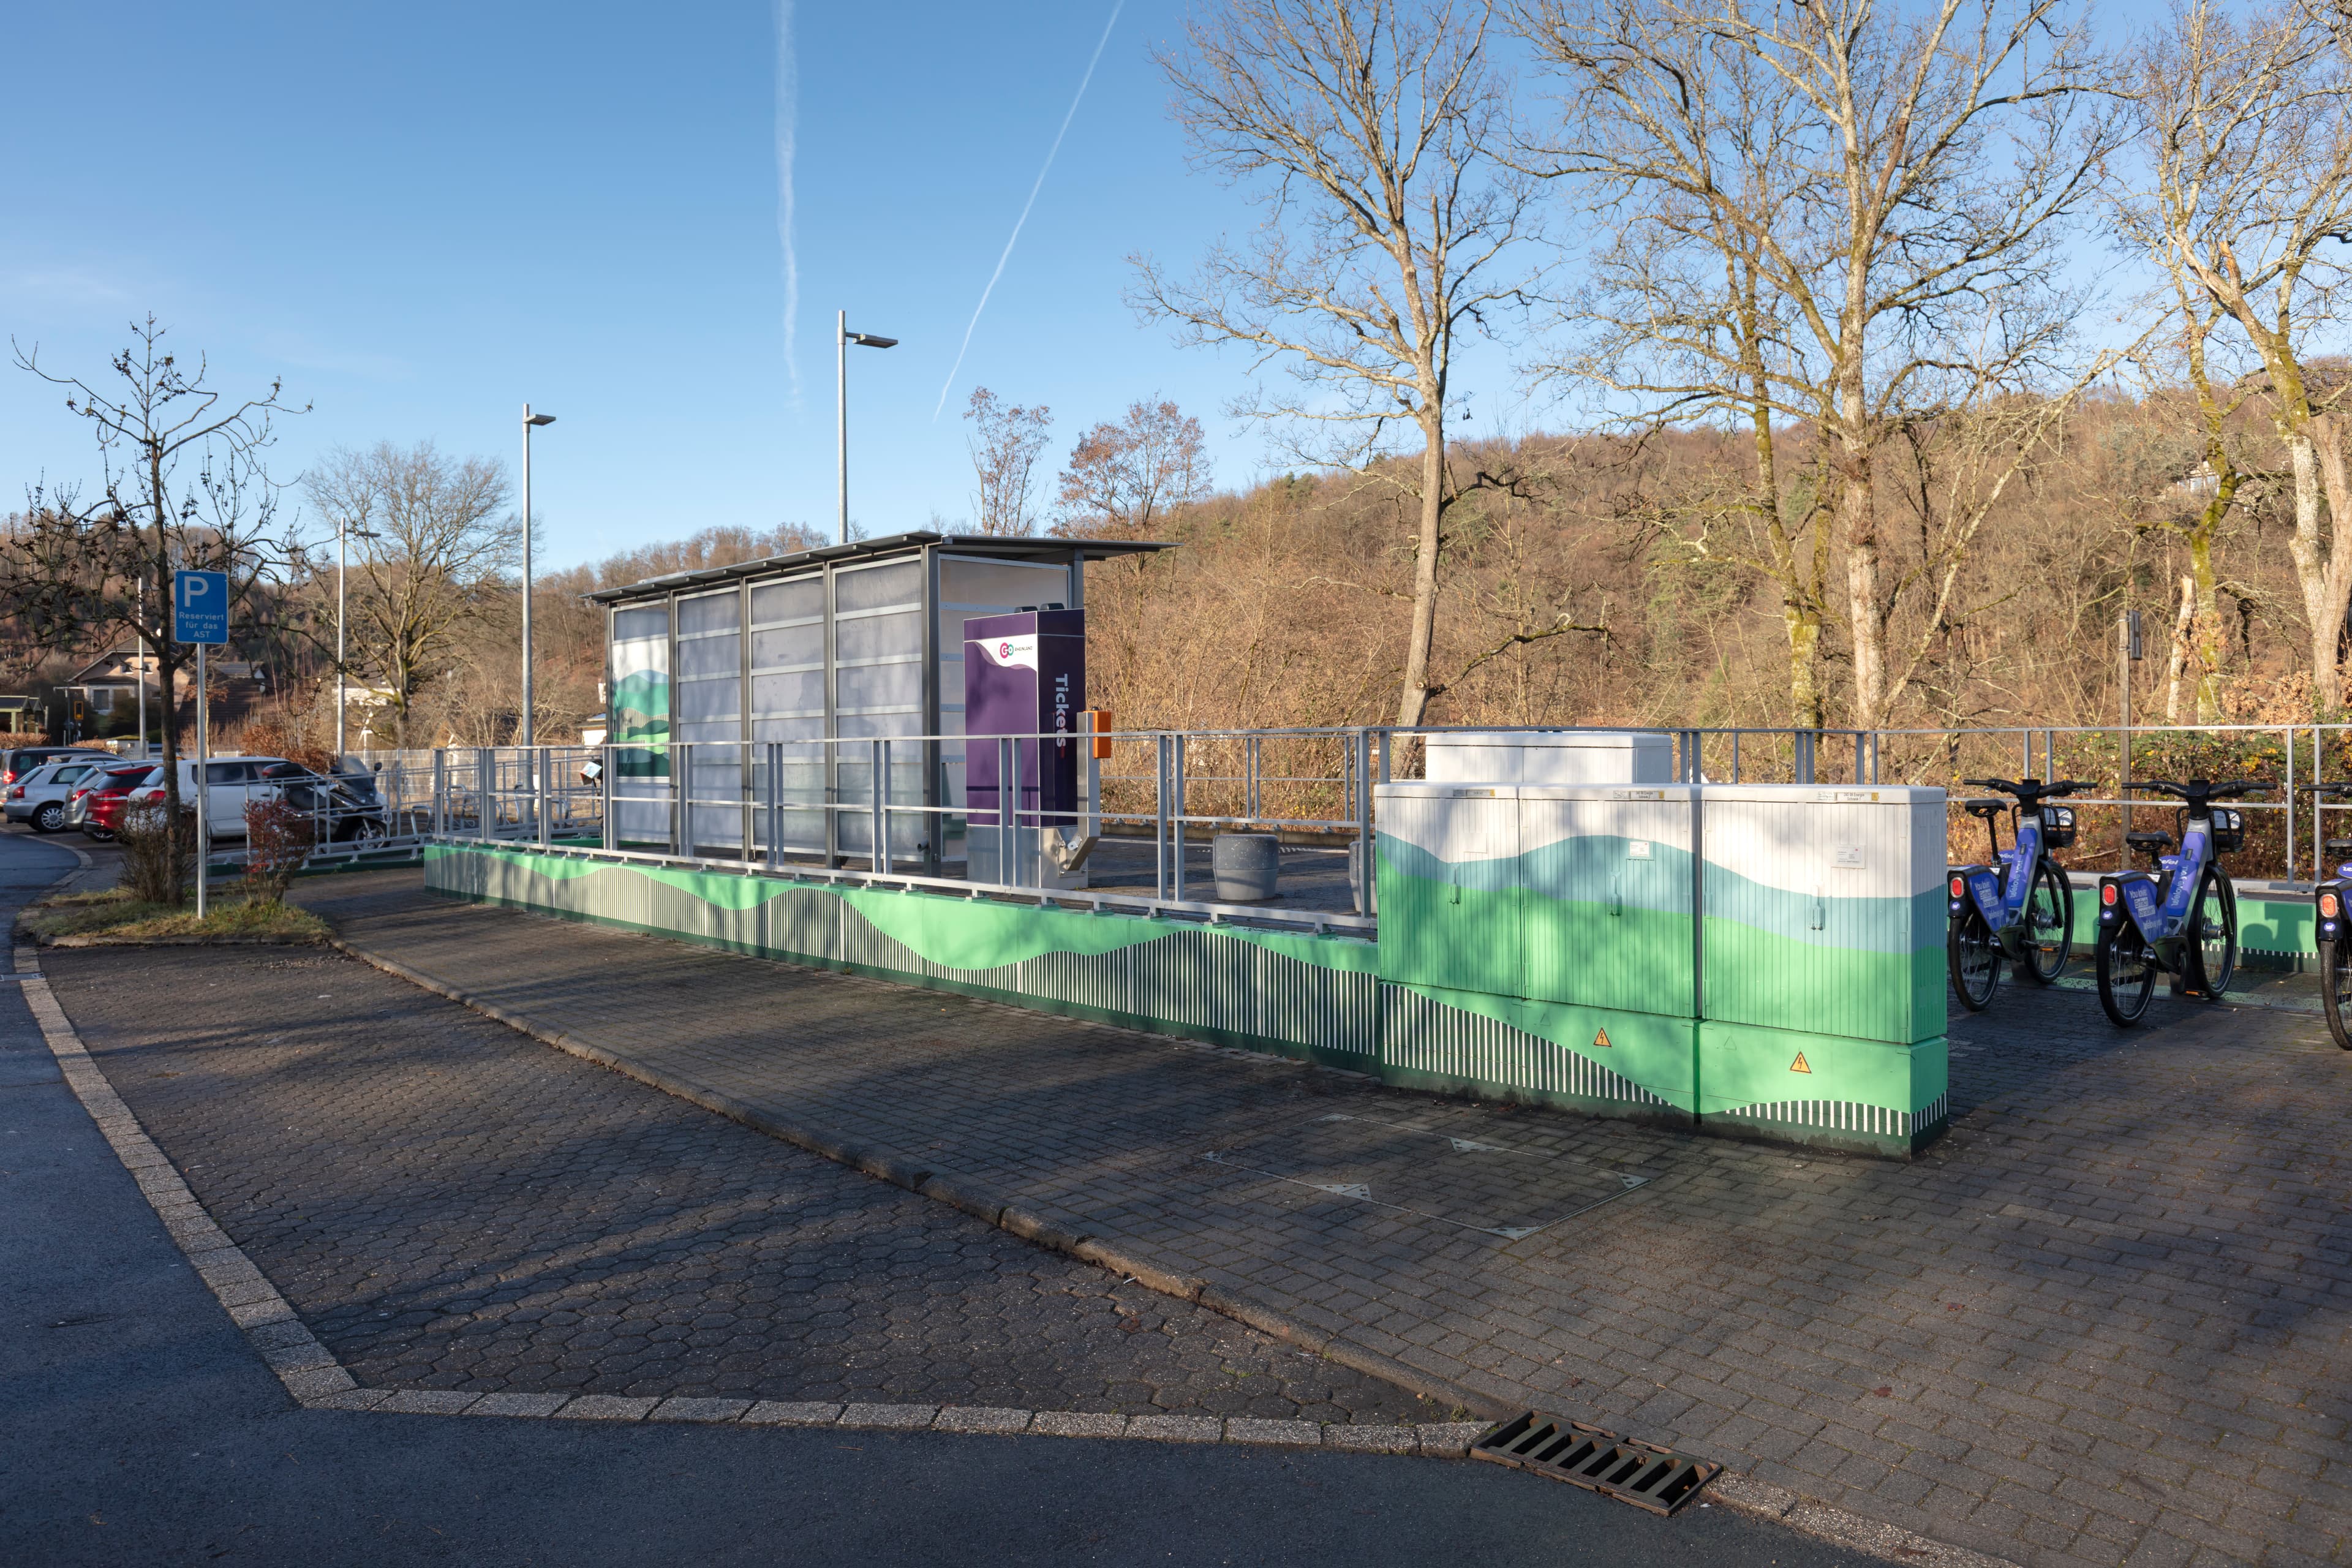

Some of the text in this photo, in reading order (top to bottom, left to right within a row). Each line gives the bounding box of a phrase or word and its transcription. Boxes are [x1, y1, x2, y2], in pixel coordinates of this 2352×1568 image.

[184, 576, 208, 607] P
[179, 612, 224, 620] Reserviert
[1055, 674, 1069, 747] Tickets
